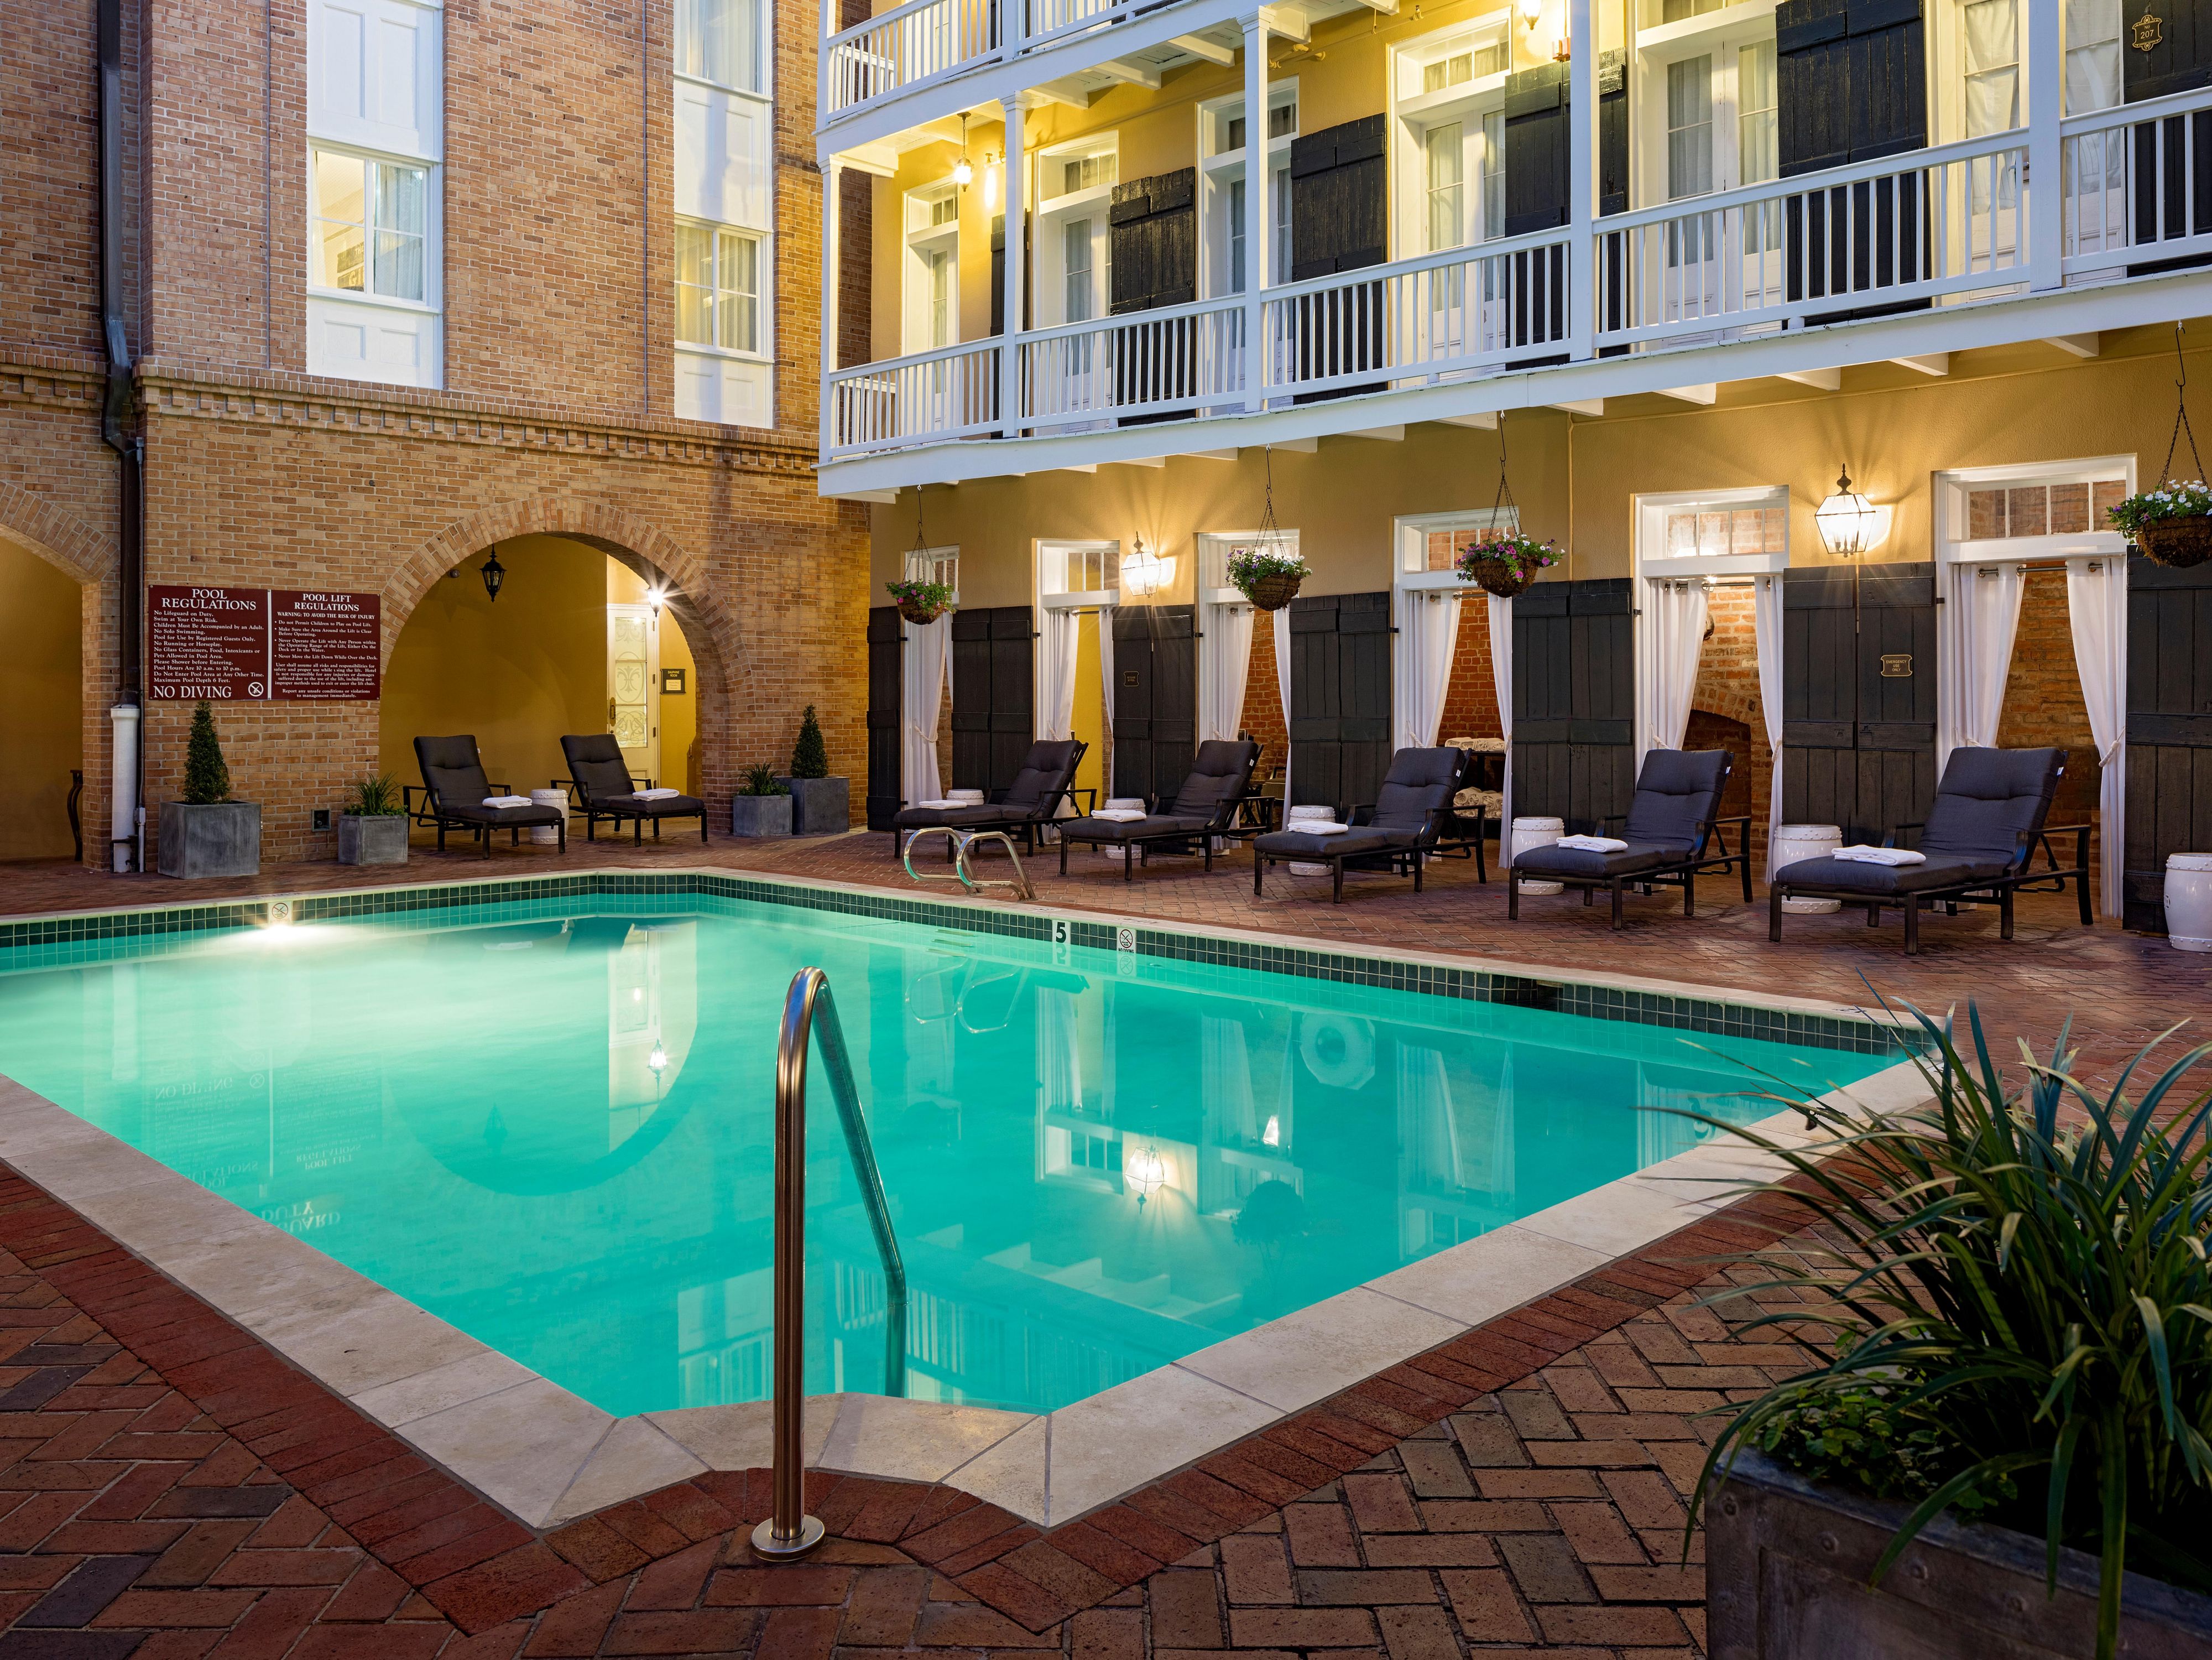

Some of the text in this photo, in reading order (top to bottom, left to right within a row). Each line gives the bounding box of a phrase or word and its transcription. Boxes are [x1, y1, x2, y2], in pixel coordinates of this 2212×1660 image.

[2140, 30, 2154, 39] 207
[192, 589, 227, 599] POOL
[162, 598, 256, 610] REGULATIONS
[295, 602, 359, 611] REGULATIONS
[153, 686, 232, 698] NO DIVING
[1056, 922, 1066, 943] 5
